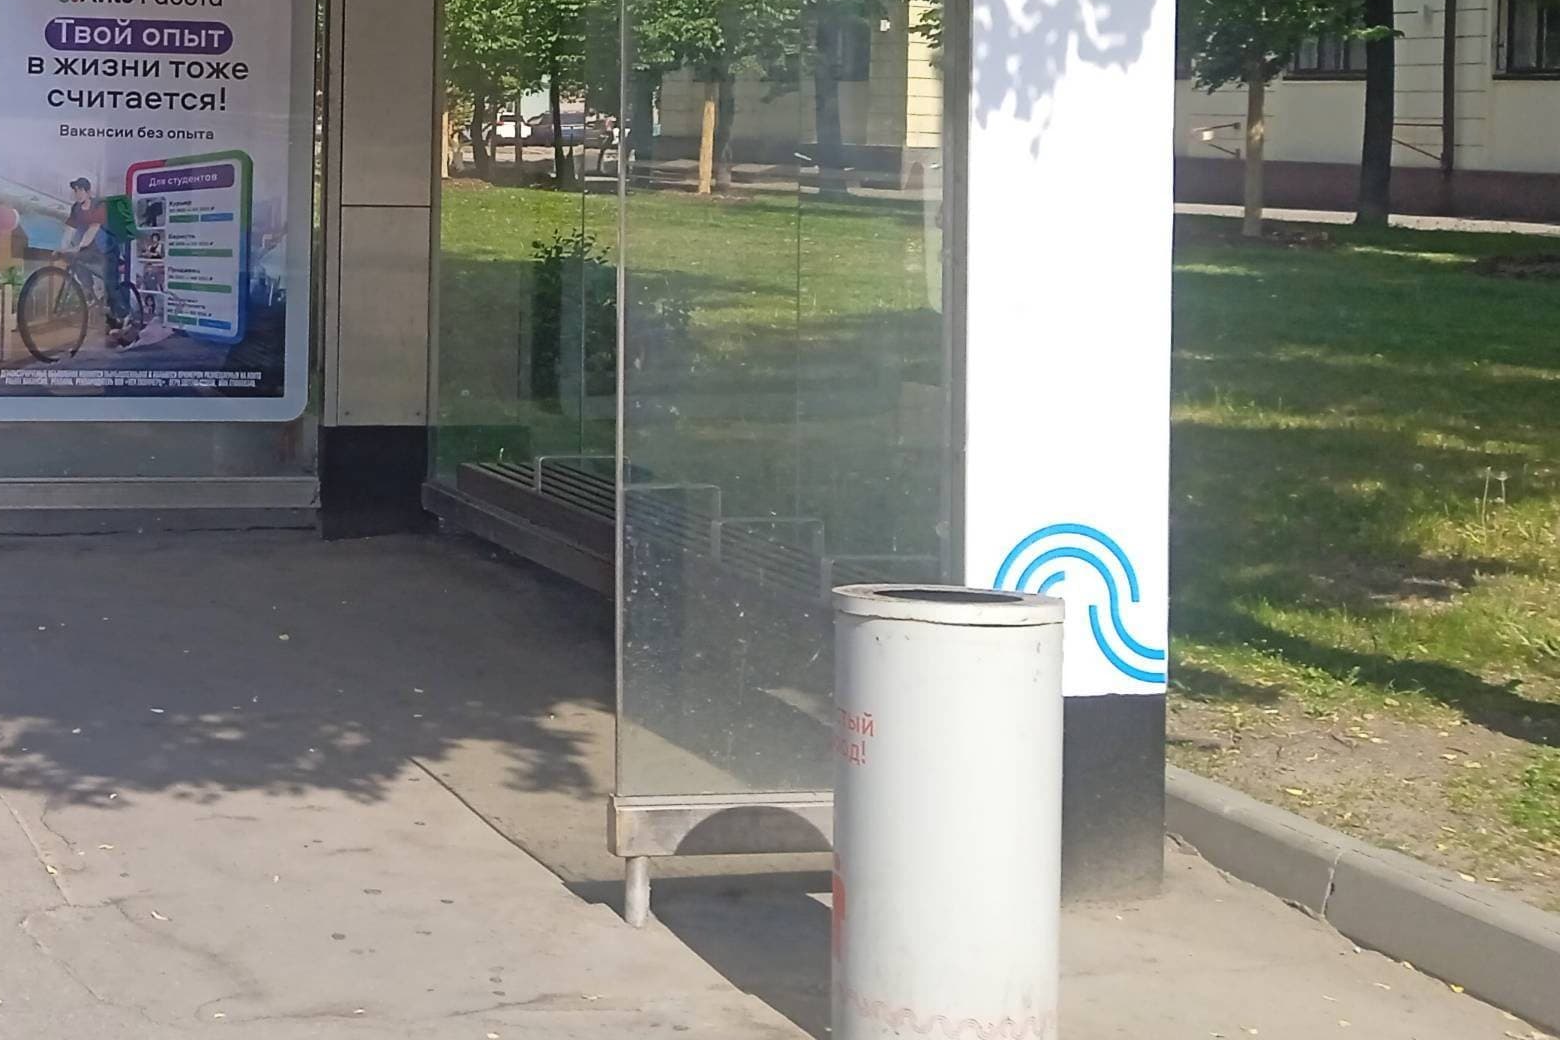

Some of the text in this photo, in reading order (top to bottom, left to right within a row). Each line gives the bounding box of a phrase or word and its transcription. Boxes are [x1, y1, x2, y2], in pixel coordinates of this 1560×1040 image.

[55, 18, 225, 48] Твой опыт
[28, 57, 249, 80] в жизни тоже
[47, 87, 226, 111] считается!
[60, 124, 214, 141] Вакансии без опыта
[148, 173, 218, 188] Для студентов
